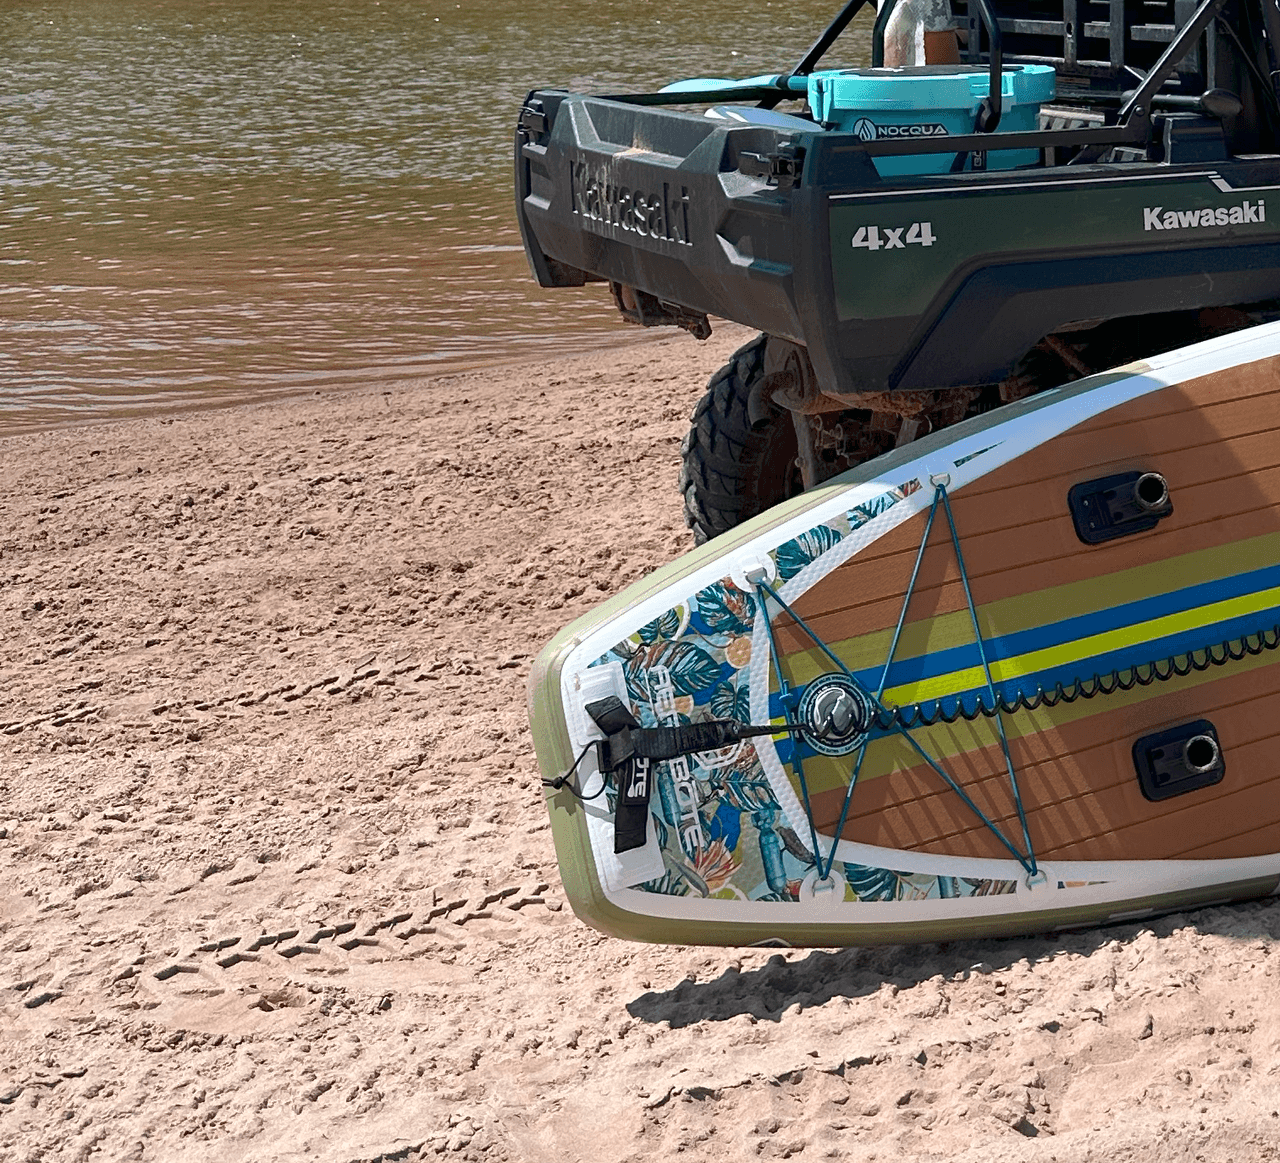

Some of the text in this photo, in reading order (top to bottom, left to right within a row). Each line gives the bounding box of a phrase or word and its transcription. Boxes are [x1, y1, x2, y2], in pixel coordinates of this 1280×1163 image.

[878, 124, 948, 136] NOCQUA
[569, 159, 694, 247] Kawasaki
[1143, 199, 1266, 231] Kawasaki
[852, 222, 937, 251] 4x4
